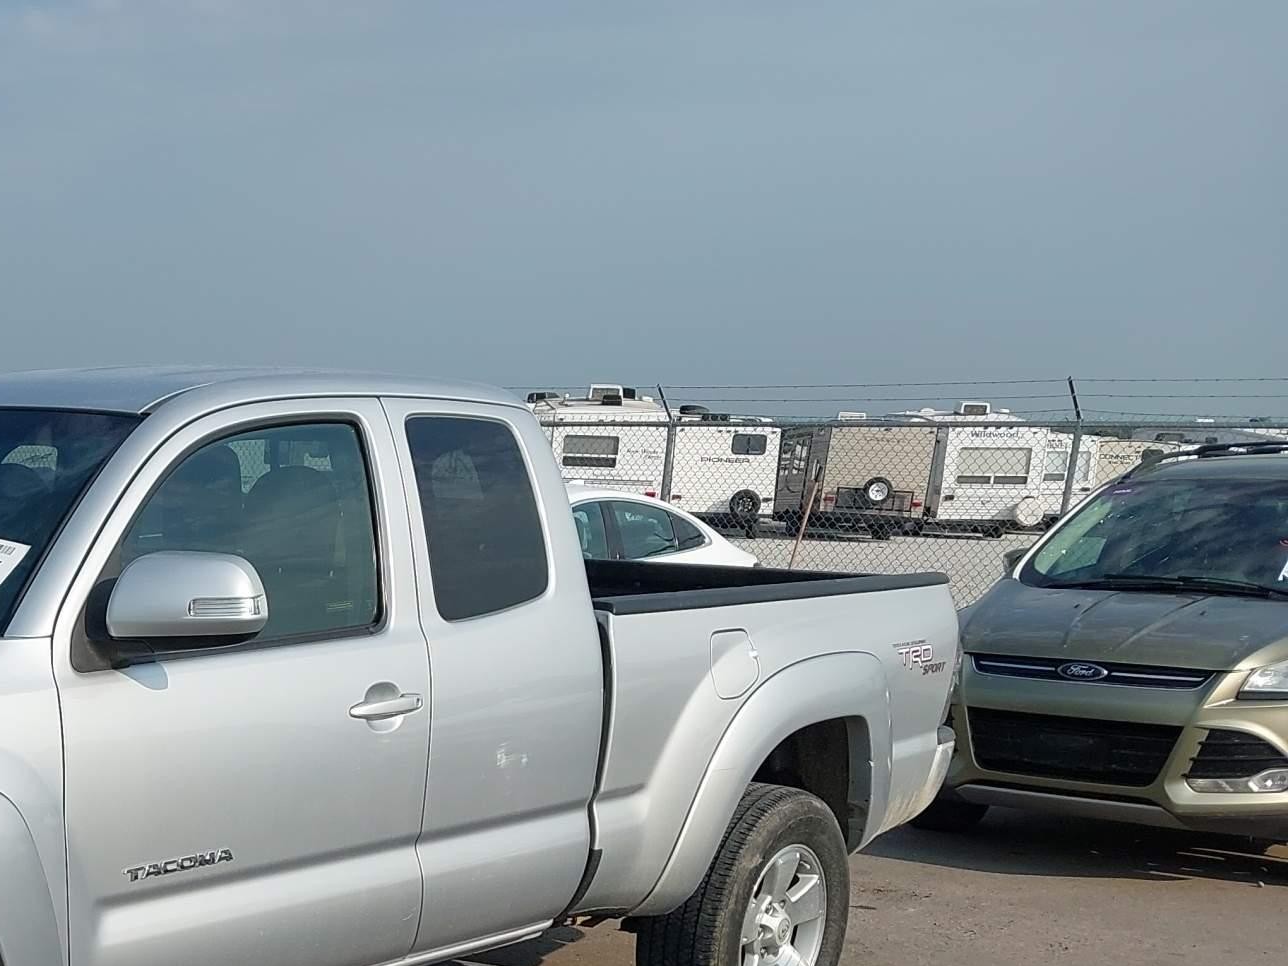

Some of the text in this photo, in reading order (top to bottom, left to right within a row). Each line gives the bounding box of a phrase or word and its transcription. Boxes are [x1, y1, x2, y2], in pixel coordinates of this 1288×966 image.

[971, 430, 1019, 439] Wildwood
[700, 456, 751, 464] PIONEER
[896, 644, 933, 671] TRD
[922, 661, 947, 676] SPORT
[1067, 664, 1096, 676] Ford
[122, 847, 234, 882] TACOMA
